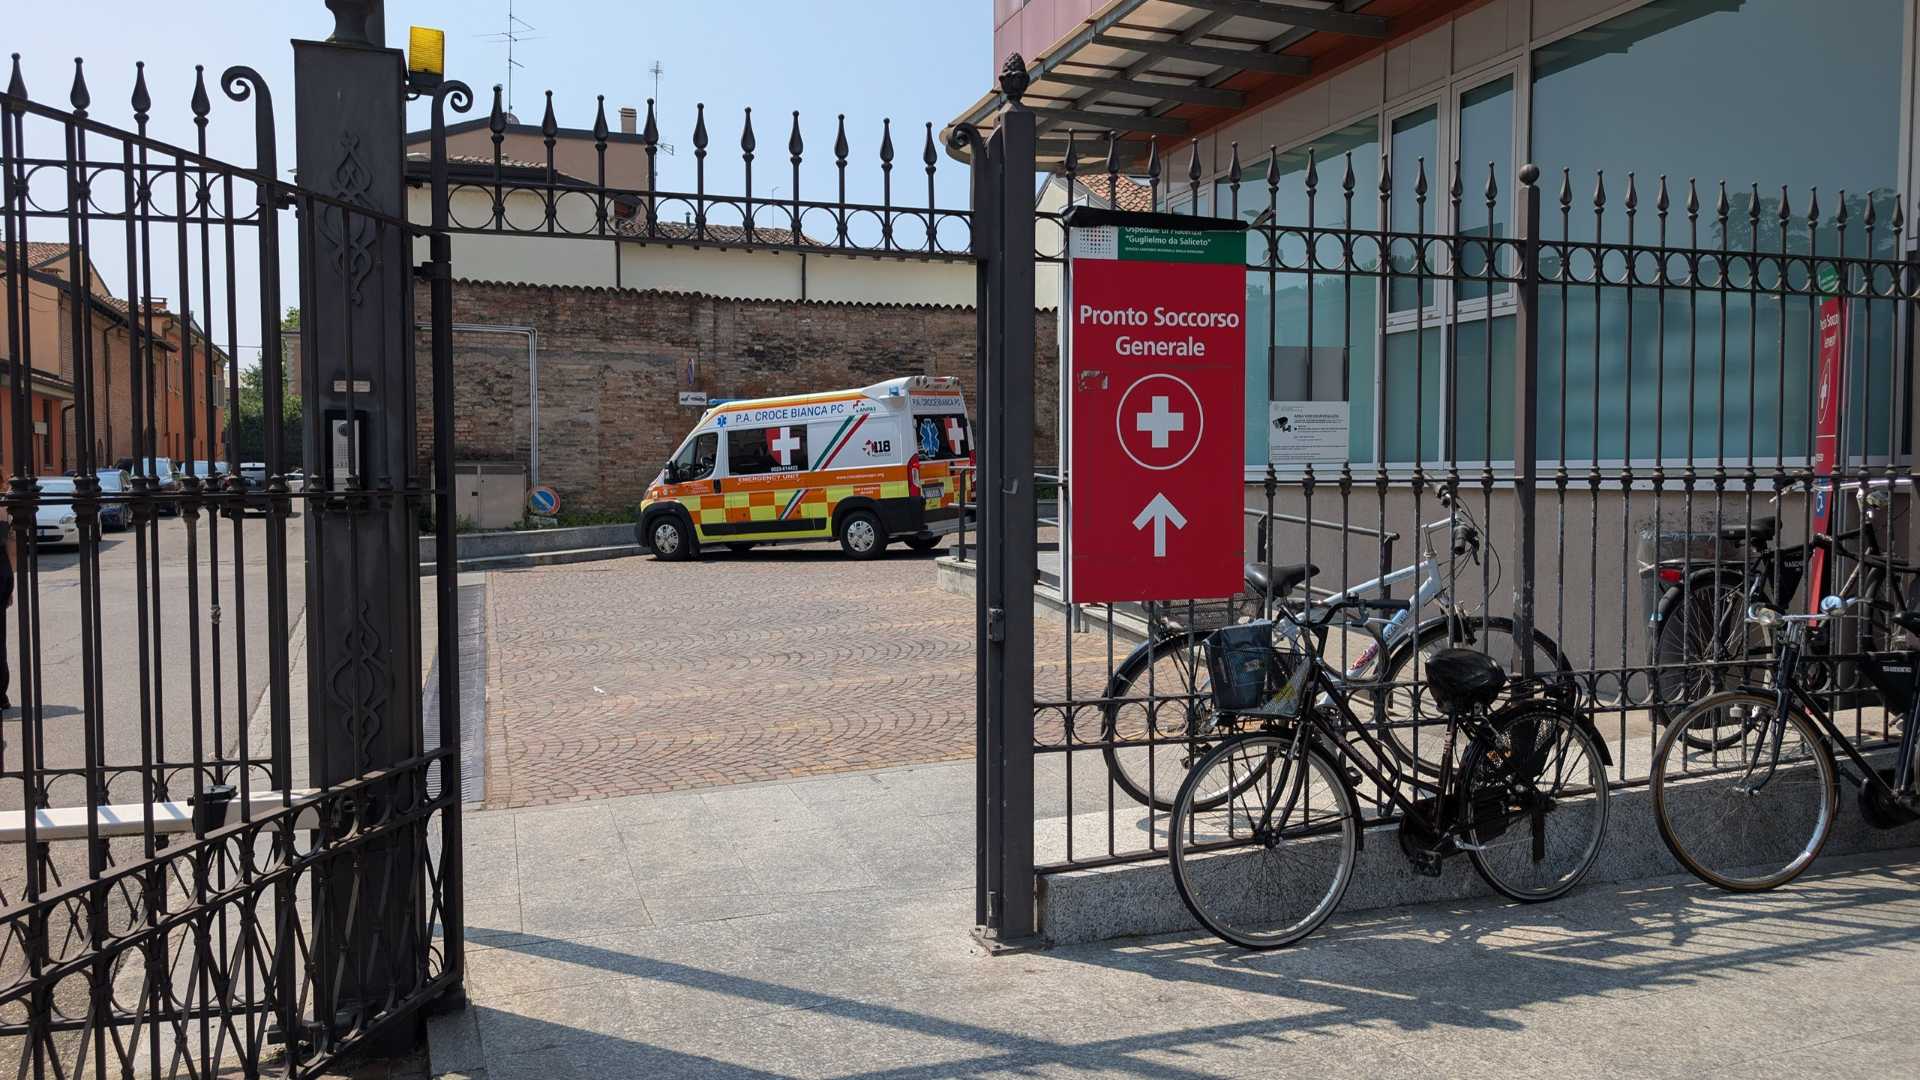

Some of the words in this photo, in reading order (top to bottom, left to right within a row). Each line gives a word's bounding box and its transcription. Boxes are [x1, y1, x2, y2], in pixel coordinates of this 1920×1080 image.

[1125, 235, 1167, 245] "Guglielmo
[1168, 237, 1178, 245] da
[1179, 237, 1211, 247] Saliceto"
[1080, 304, 1148, 326] Pronto
[1154, 306, 1240, 328] Soccorso
[1115, 335, 1206, 357] Generale
[735, 413, 752, 423] P.A.
[755, 410, 788, 422] CROCE
[791, 406, 828, 419] BIANCA
[830, 403, 844, 414] PC
[873, 439, 891, 454] 118
